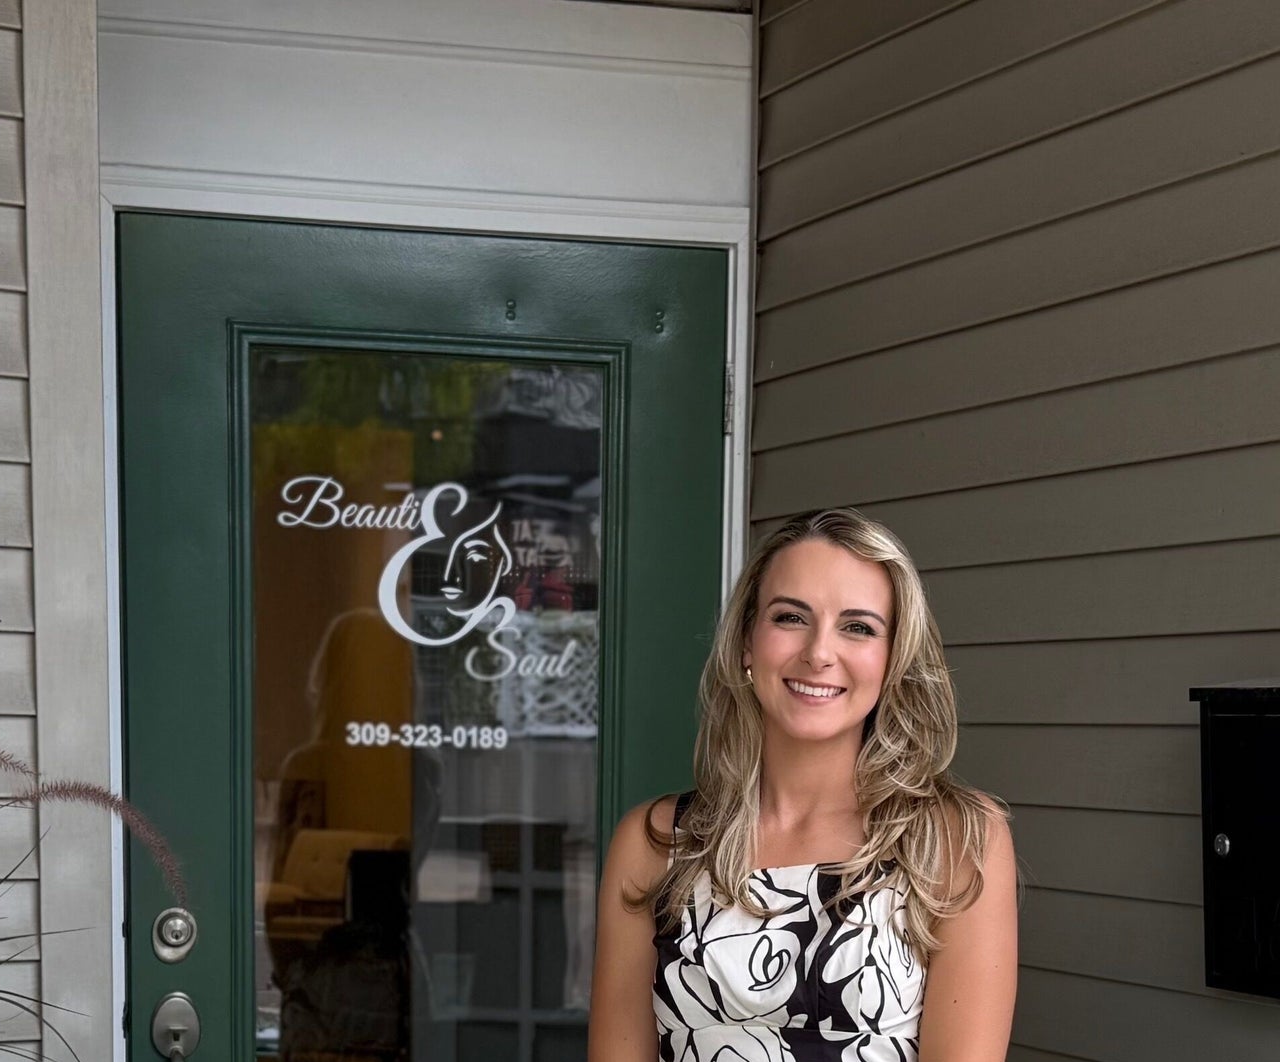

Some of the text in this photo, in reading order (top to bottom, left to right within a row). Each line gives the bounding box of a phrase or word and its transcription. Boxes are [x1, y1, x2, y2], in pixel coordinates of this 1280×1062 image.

[277, 476, 421, 529] Beauti
[465, 626, 577, 682] Soul
[345, 722, 507, 749] 309-323-0189
